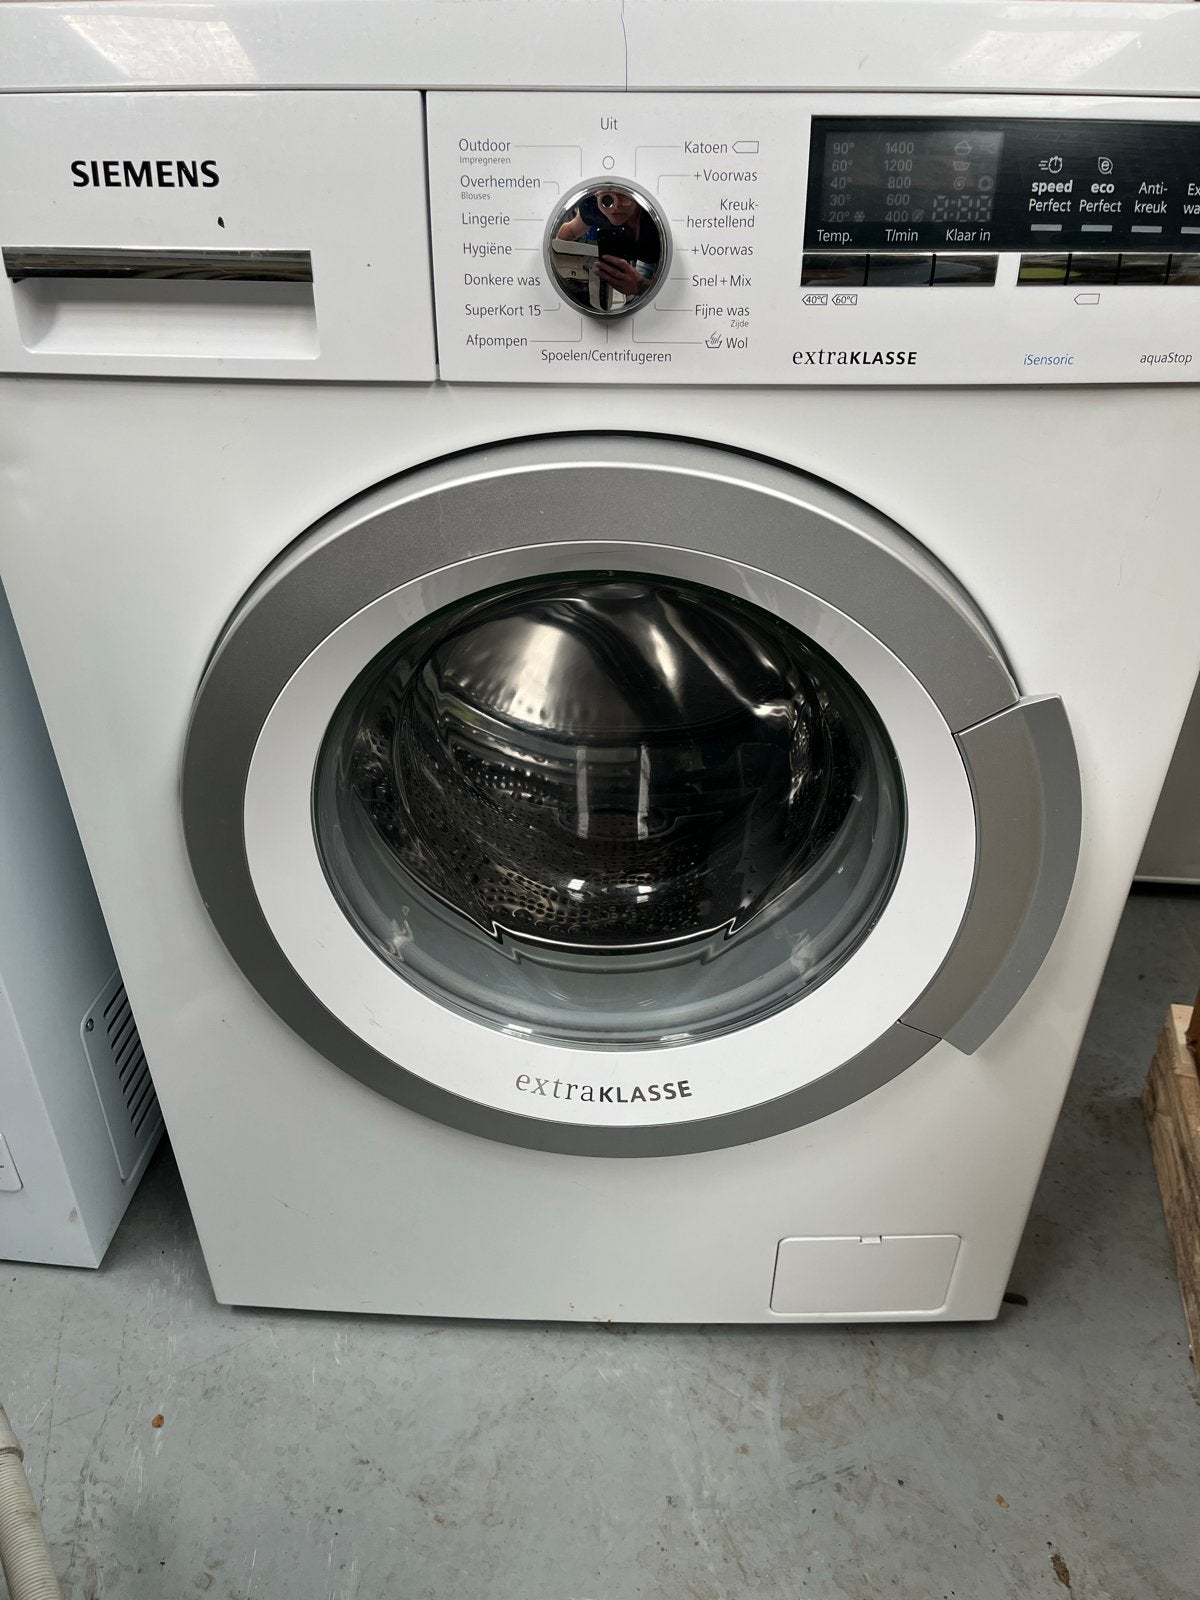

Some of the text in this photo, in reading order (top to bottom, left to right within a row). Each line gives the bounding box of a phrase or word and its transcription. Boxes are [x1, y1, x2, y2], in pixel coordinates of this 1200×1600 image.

[600, 117, 618, 130] Uit
[458, 138, 511, 152] Outdoor
[684, 140, 728, 154] Katoen
[885, 142, 914, 155] 1400
[459, 155, 511, 166] Impregneren
[884, 159, 913, 172] 1200
[70, 159, 220, 189] SIEMENS
[460, 175, 541, 188] Overhemden
[888, 176, 912, 189] 800
[1031, 179, 1073, 196] speed
[1090, 182, 1115, 194] eco
[1138, 181, 1168, 195] Anti-
[460, 191, 491, 201] Blouses
[886, 193, 910, 206] 600
[720, 198, 759, 211] Kreuk-
[1028, 198, 1072, 213] Perfect
[1079, 199, 1122, 213] Perfect
[1134, 199, 1168, 214] kreuk
[462, 212, 510, 228] Lingerie
[686, 215, 755, 229] herstellend
[884, 210, 909, 222] 400
[817, 229, 853, 245] Temp.
[885, 229, 919, 242] T/min
[945, 229, 991, 242] Klaar in
[463, 242, 512, 258] Hygiëne
[464, 273, 541, 286] Donkere was
[465, 304, 542, 319] SuperKort 15
[695, 304, 750, 320] Fijne was
[730, 319, 750, 329] Zijde
[466, 334, 528, 350] Afpompen
[726, 336, 749, 349] Wol
[541, 349, 672, 365] Spoelen/Centrifugeren
[1023, 352, 1075, 366] iSensoric
[1139, 352, 1193, 365] aquaStop
